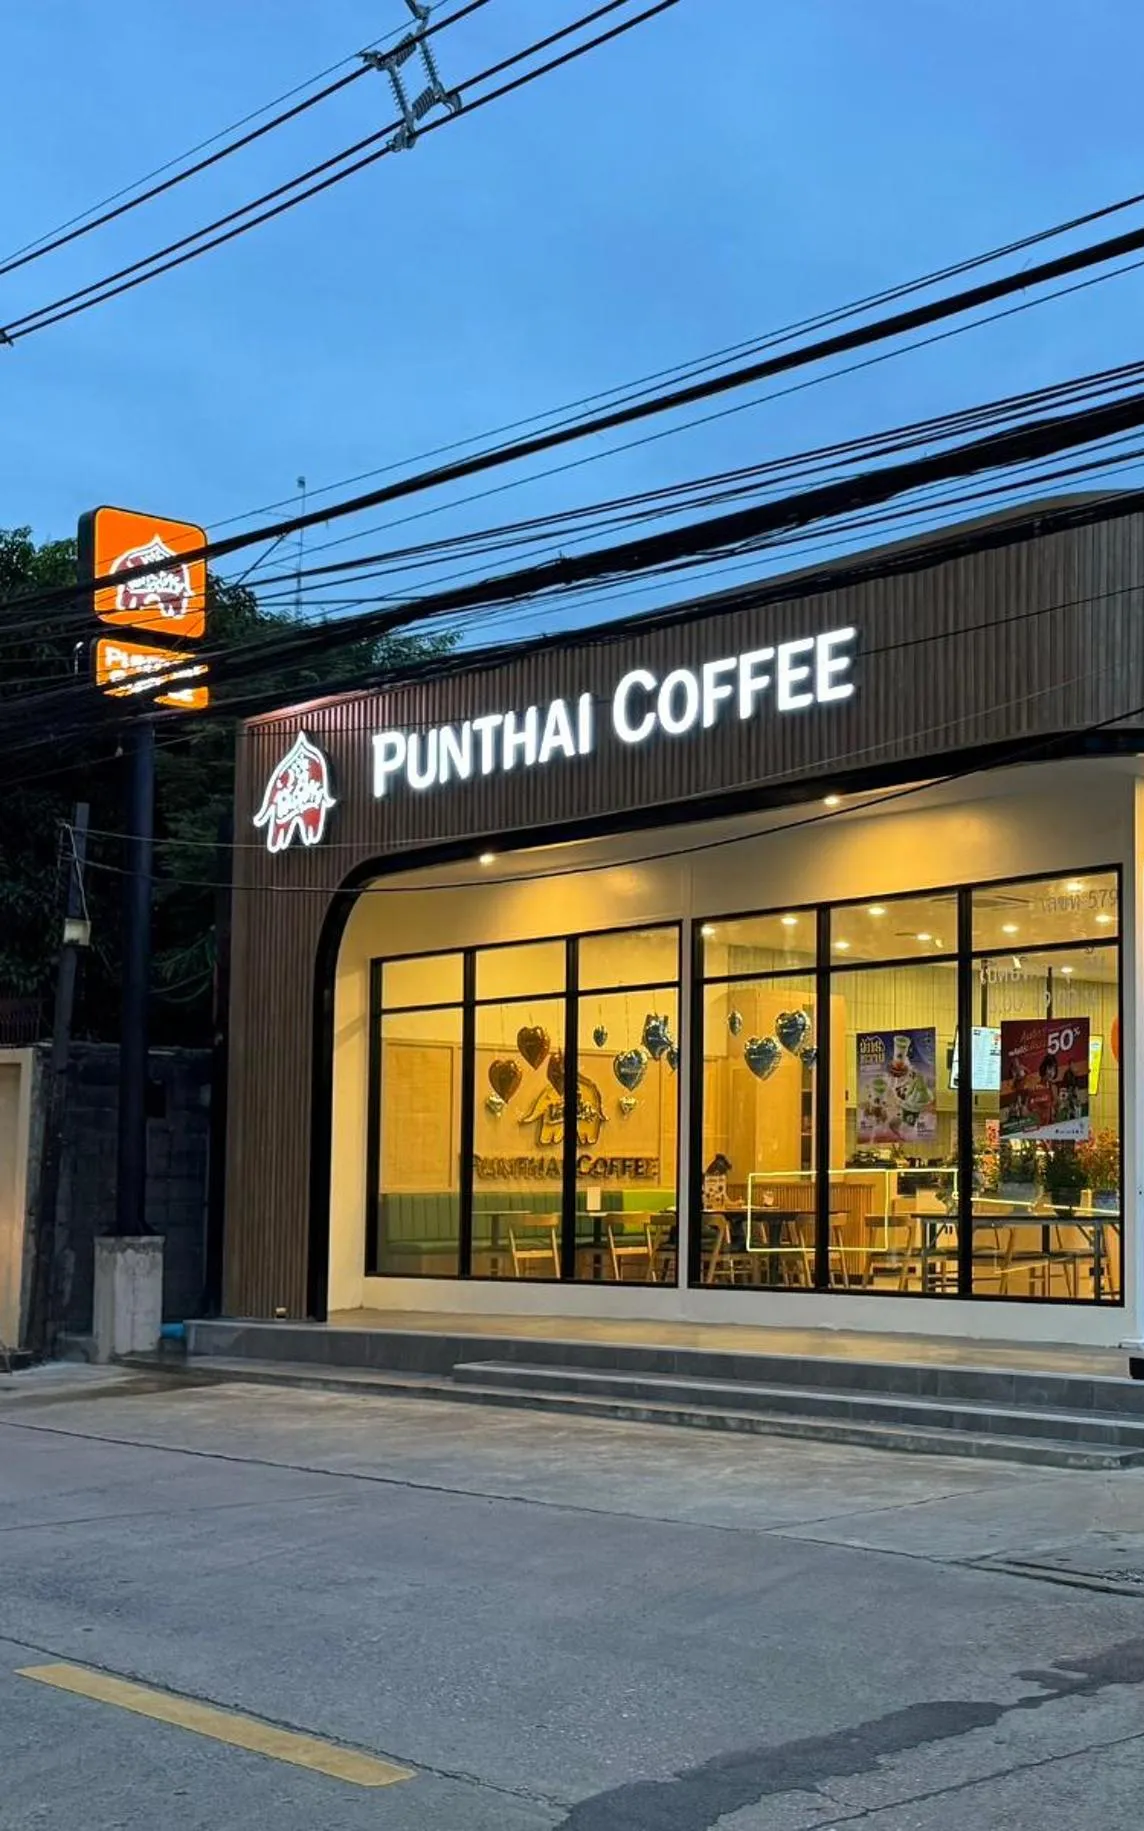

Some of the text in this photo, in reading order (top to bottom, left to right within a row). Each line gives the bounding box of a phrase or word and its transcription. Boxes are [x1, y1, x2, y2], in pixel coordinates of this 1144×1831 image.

[372, 625, 858, 798] PUNTHAI COFFEE
[576, 1153, 659, 1178] COFFEE
